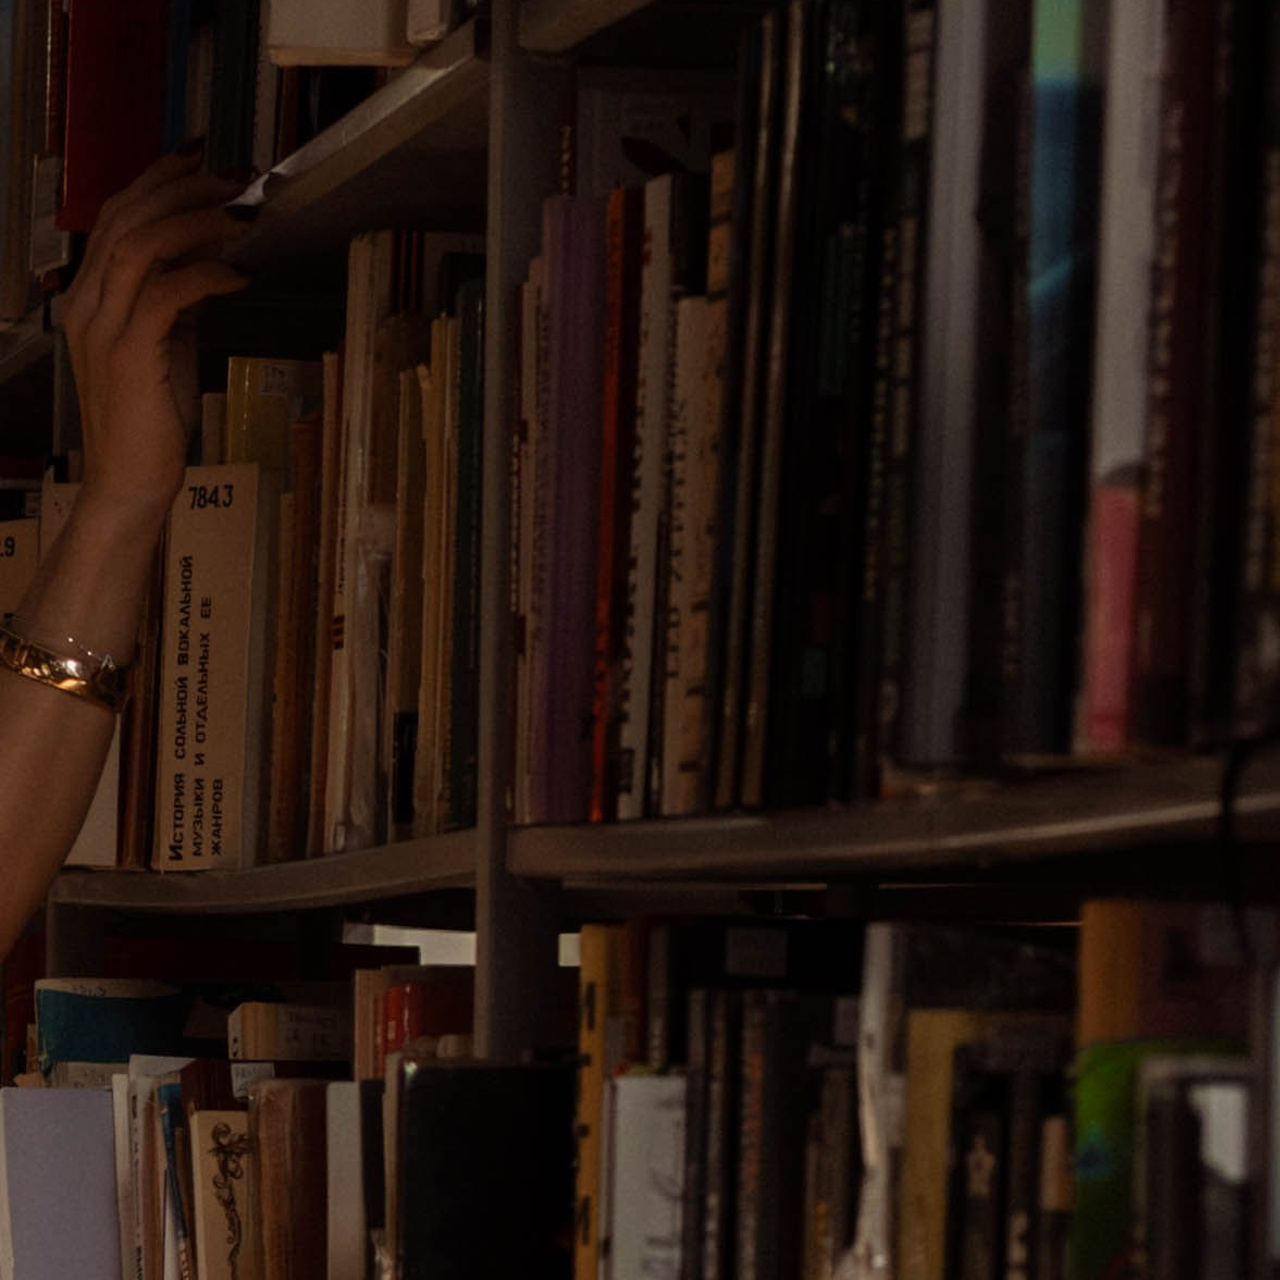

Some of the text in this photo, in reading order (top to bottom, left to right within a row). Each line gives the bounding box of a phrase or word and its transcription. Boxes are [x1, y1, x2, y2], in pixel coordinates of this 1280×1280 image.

[175, 556, 194, 666] ВОКАЛЬНОЙ
[172, 676, 189, 759] СОЛЬНОЙ
[191, 597, 212, 858] МУЗЫКИ И ОТДЕЛЬНЫХ ЕЕ
[210, 779, 224, 858] ЖАНРОВ
